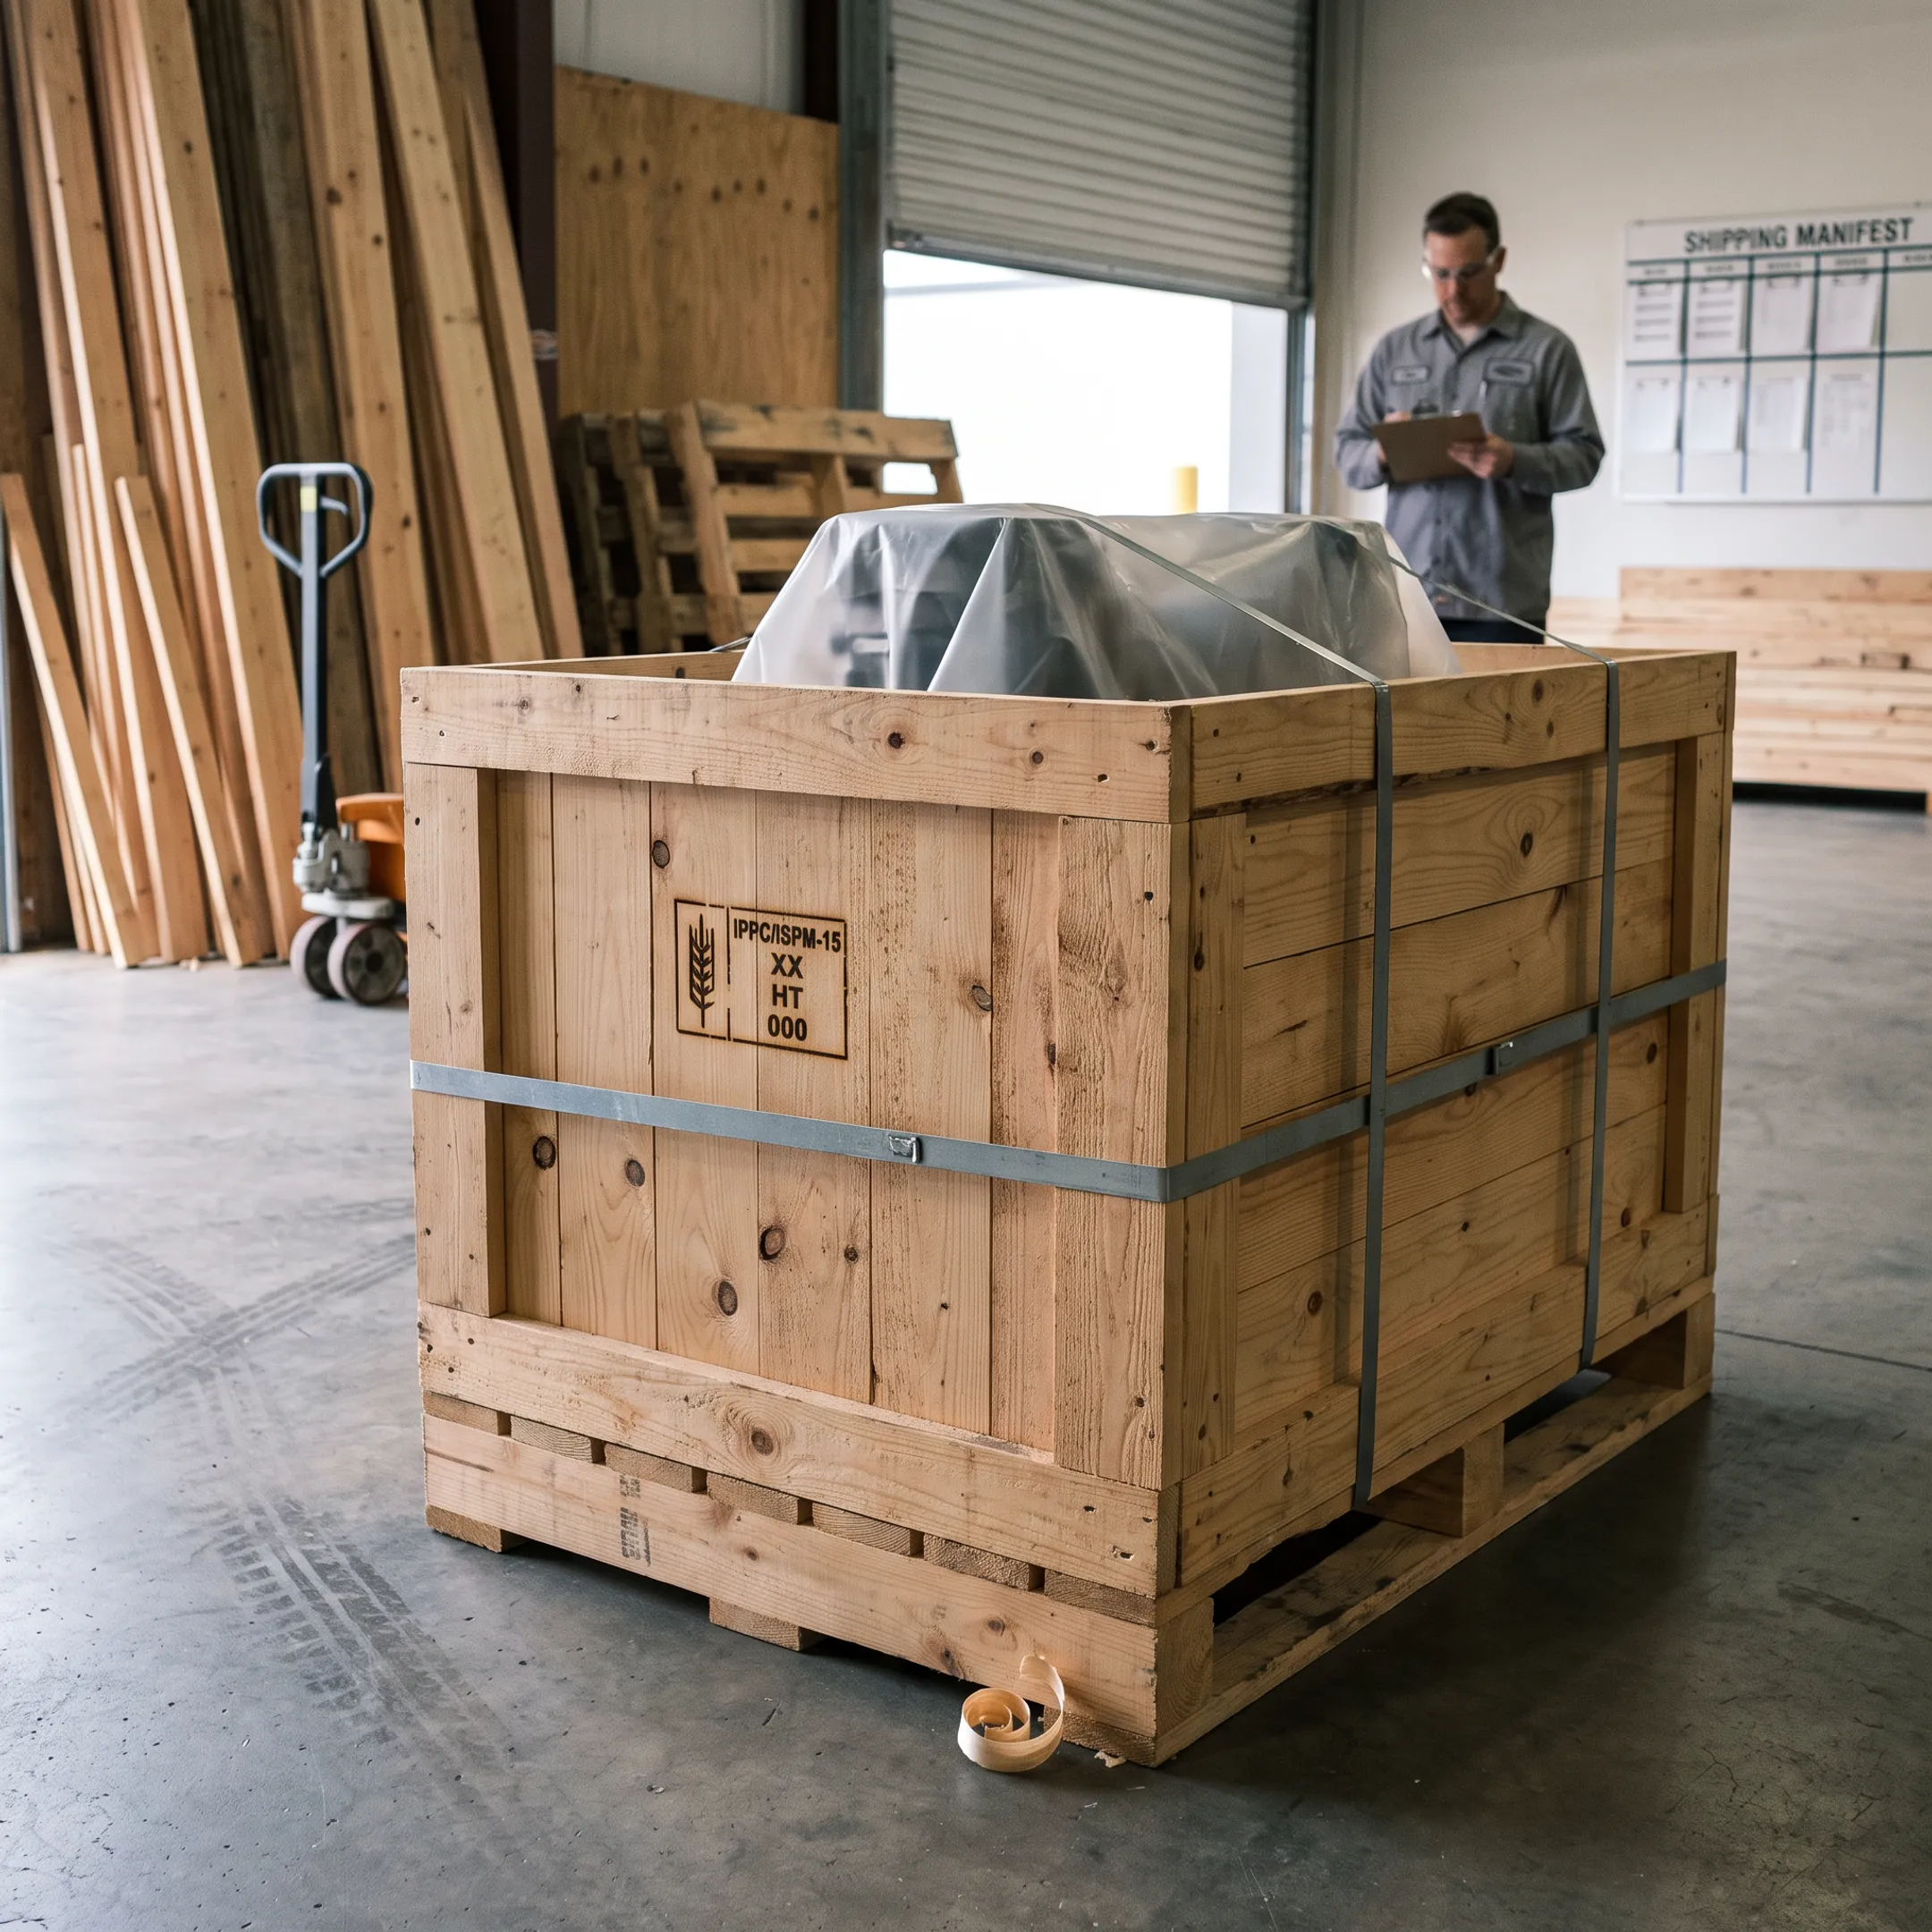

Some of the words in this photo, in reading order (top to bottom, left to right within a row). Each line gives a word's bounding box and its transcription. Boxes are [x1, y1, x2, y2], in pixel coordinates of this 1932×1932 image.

[1685, 225, 1787, 253] SHIPPING
[1796, 217, 1914, 246] MANIFEST
[733, 918, 841, 953] IPPC/ISPM-15
[770, 953, 803, 979] XX
[772, 984, 803, 1009] HT
[767, 1013, 807, 1041] 000
